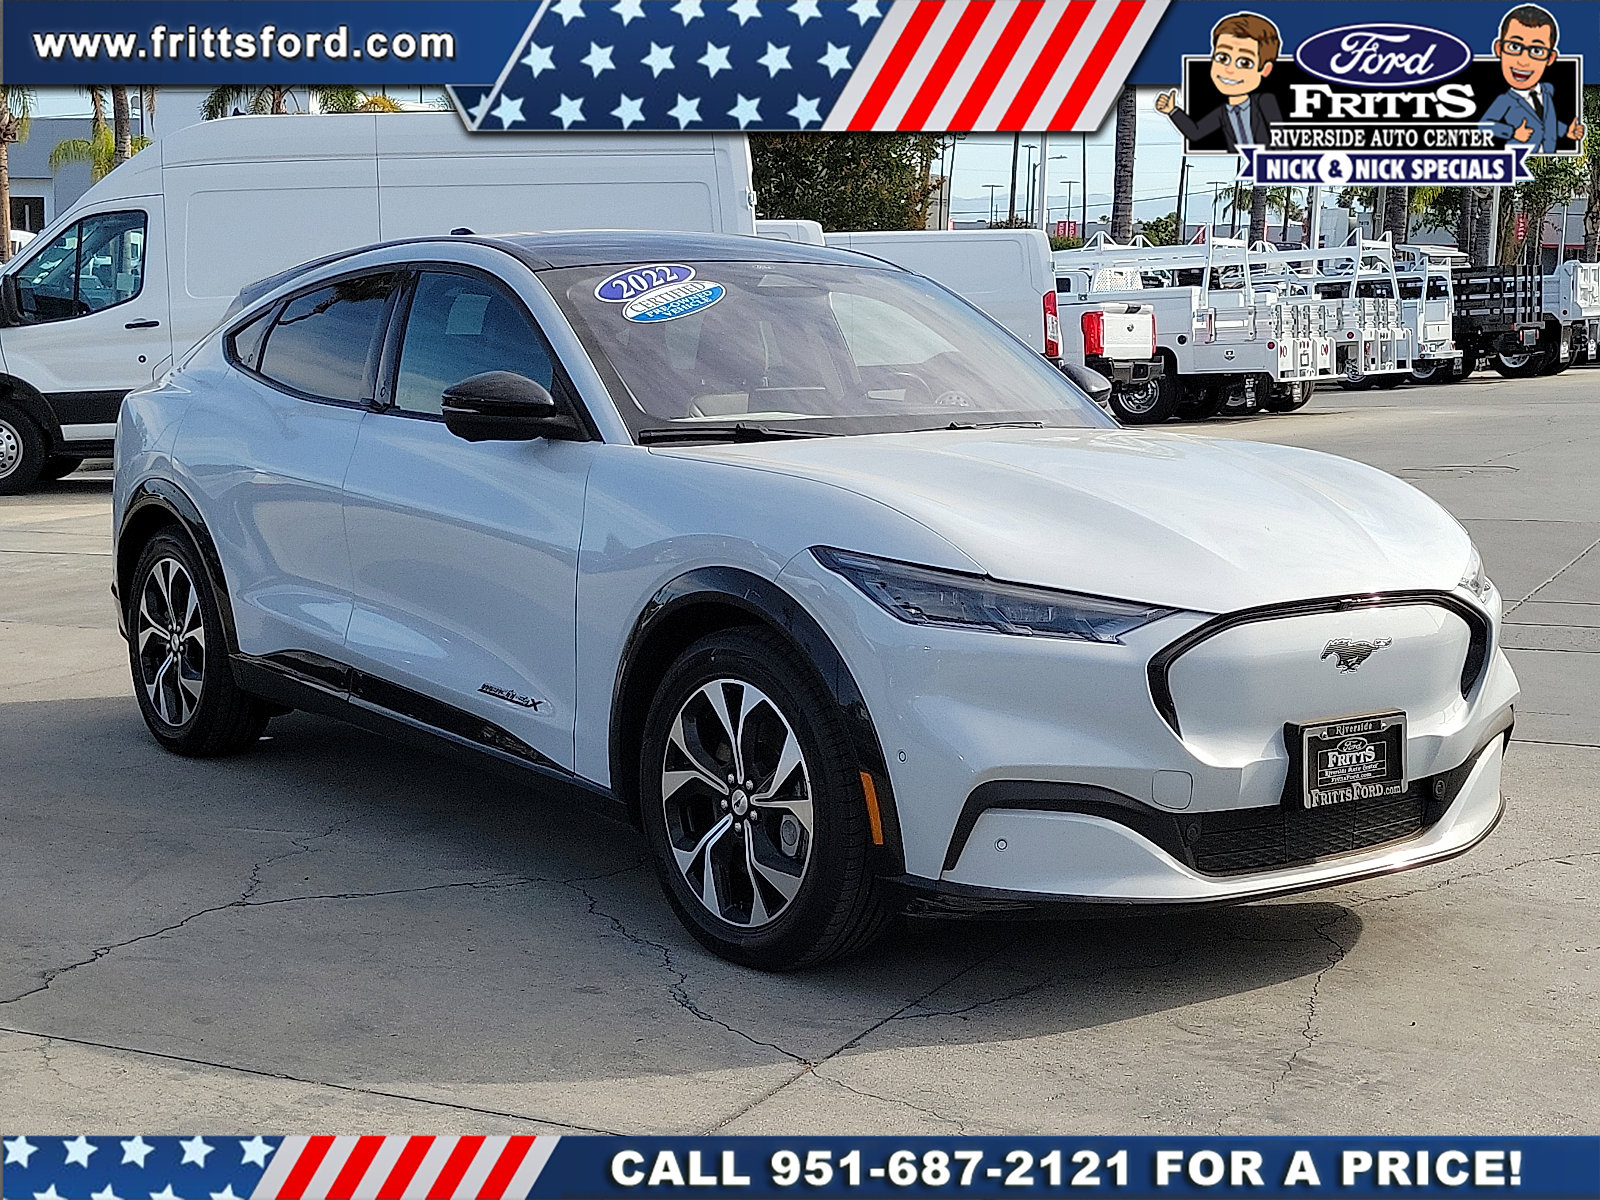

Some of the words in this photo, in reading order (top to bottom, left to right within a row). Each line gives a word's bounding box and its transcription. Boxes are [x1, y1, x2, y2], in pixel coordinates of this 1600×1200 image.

[612, 265, 679, 299] 2022
[630, 282, 706, 313] CERTIFIED
[645, 290, 712, 317] PRE-OWNED
[662, 297, 713, 317] VEHICLE
[1335, 721, 1373, 736] Riverside
[1342, 740, 1363, 751] Ford
[1328, 746, 1375, 767] FRITTS
